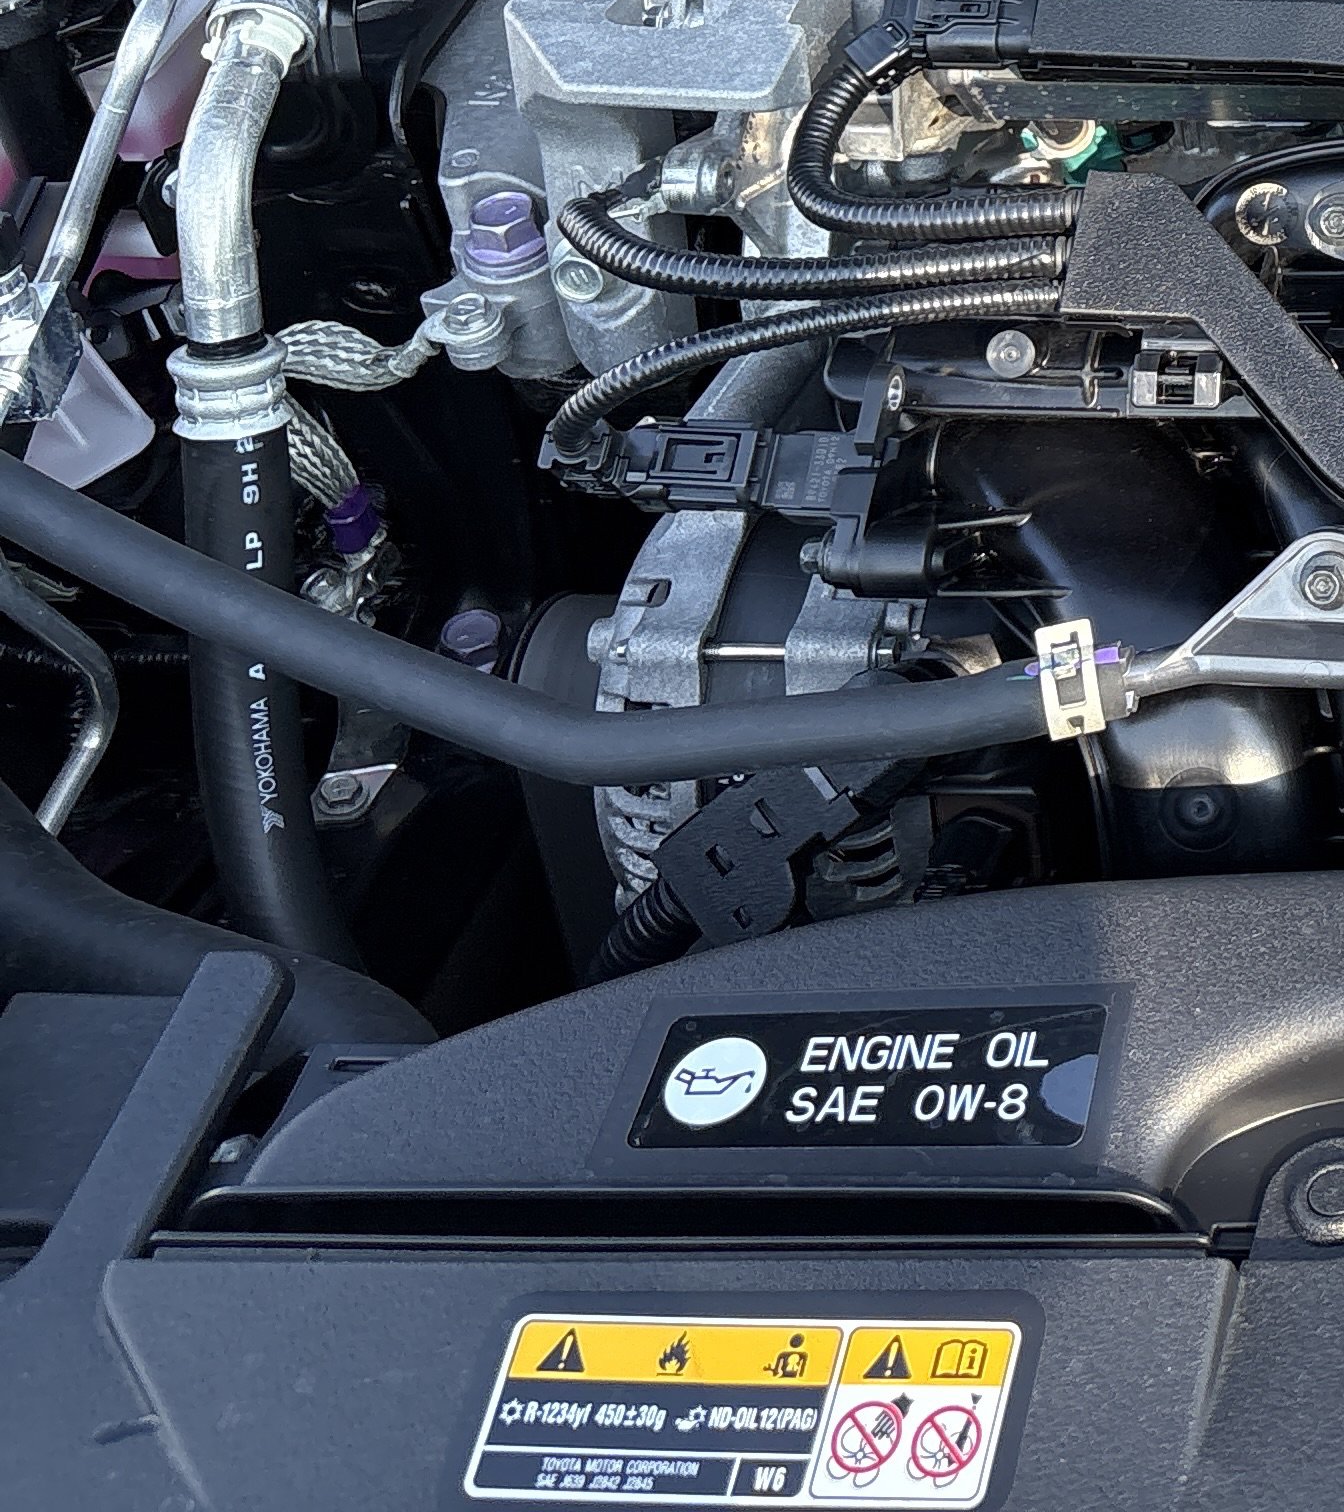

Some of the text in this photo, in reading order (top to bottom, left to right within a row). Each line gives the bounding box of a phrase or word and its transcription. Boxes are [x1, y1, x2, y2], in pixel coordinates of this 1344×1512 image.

[245, 531, 263, 570] LP
[250, 696, 279, 806] YOKOHAMA
[801, 1030, 1050, 1073] ENGINE OIL
[784, 1082, 1029, 1124] SAE 0W-8
[523, 1401, 593, 1431] R-1234yf
[594, 1404, 668, 1432] 450±30g
[535, 1473, 558, 1488] SAE
[541, 1456, 700, 1478] TOYOTA MOTOR CORPORATION
[754, 1465, 788, 1493] W6
